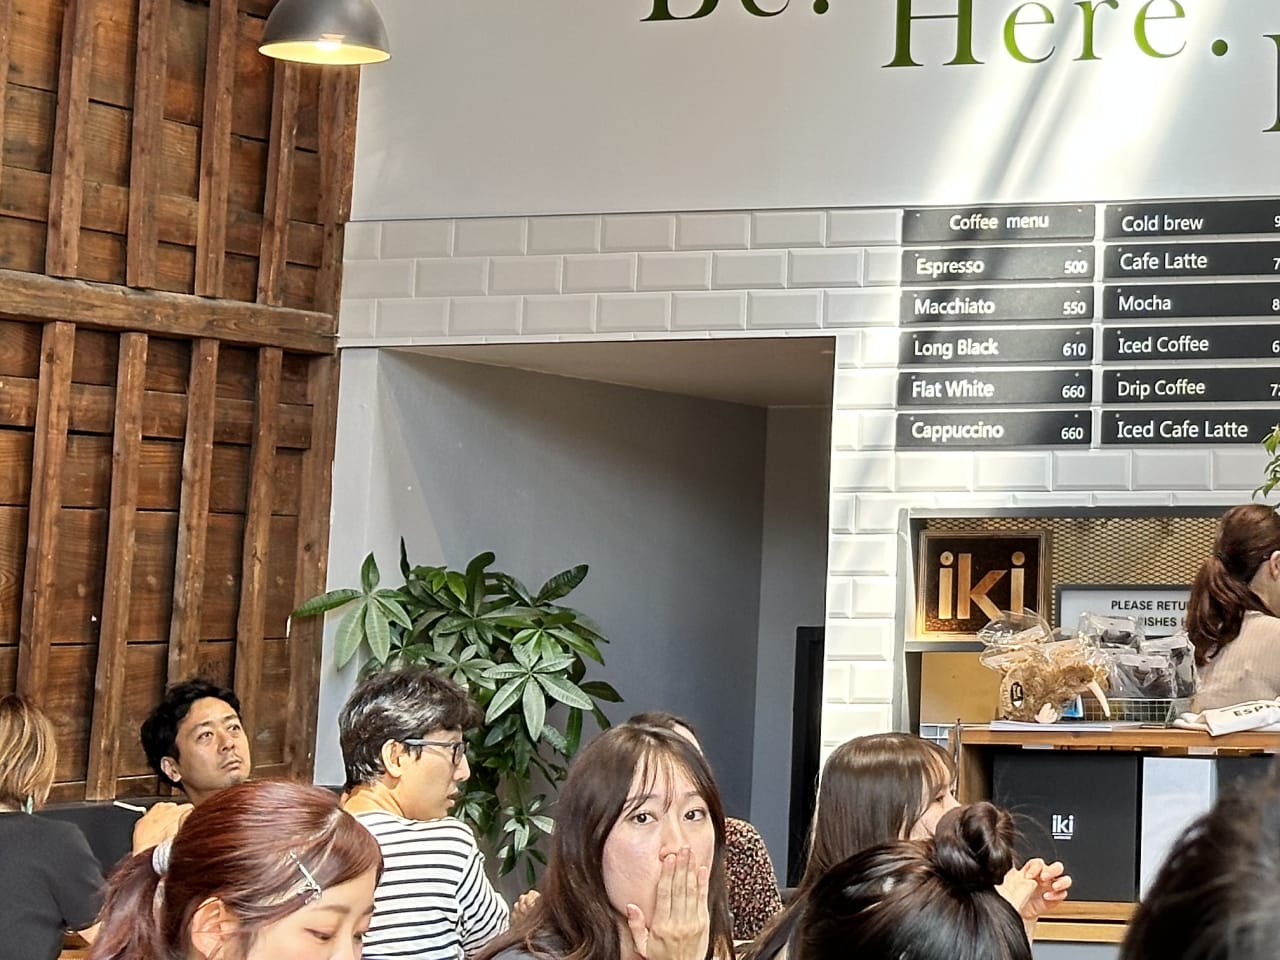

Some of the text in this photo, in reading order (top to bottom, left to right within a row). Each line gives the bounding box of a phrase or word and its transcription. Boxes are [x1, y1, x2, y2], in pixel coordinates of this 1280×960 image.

[949, 213, 1049, 231] Coffee menu
[1121, 215, 1159, 232] Cold
[1164, 214, 1204, 231] brew
[916, 258, 1088, 277] Espresso 500
[1120, 252, 1160, 271] Cafe
[1164, 252, 1208, 270] Latte
[914, 298, 1087, 315] Macchiato 550
[1118, 294, 1172, 311] Mocha
[914, 338, 1087, 359] Long Black 610
[1117, 337, 1153, 354] Iced
[1156, 335, 1210, 353] Coffee
[912, 379, 1086, 398] Flat White 660
[1117, 380, 1151, 401] Drip
[1154, 378, 1206, 396] Coffee
[911, 421, 1084, 443] Cappuccino 660
[1116, 420, 1249, 438] Iced Cafe Latte
[938, 551, 1025, 622] iki
[1111, 600, 1186, 611] PLEASE RETU
